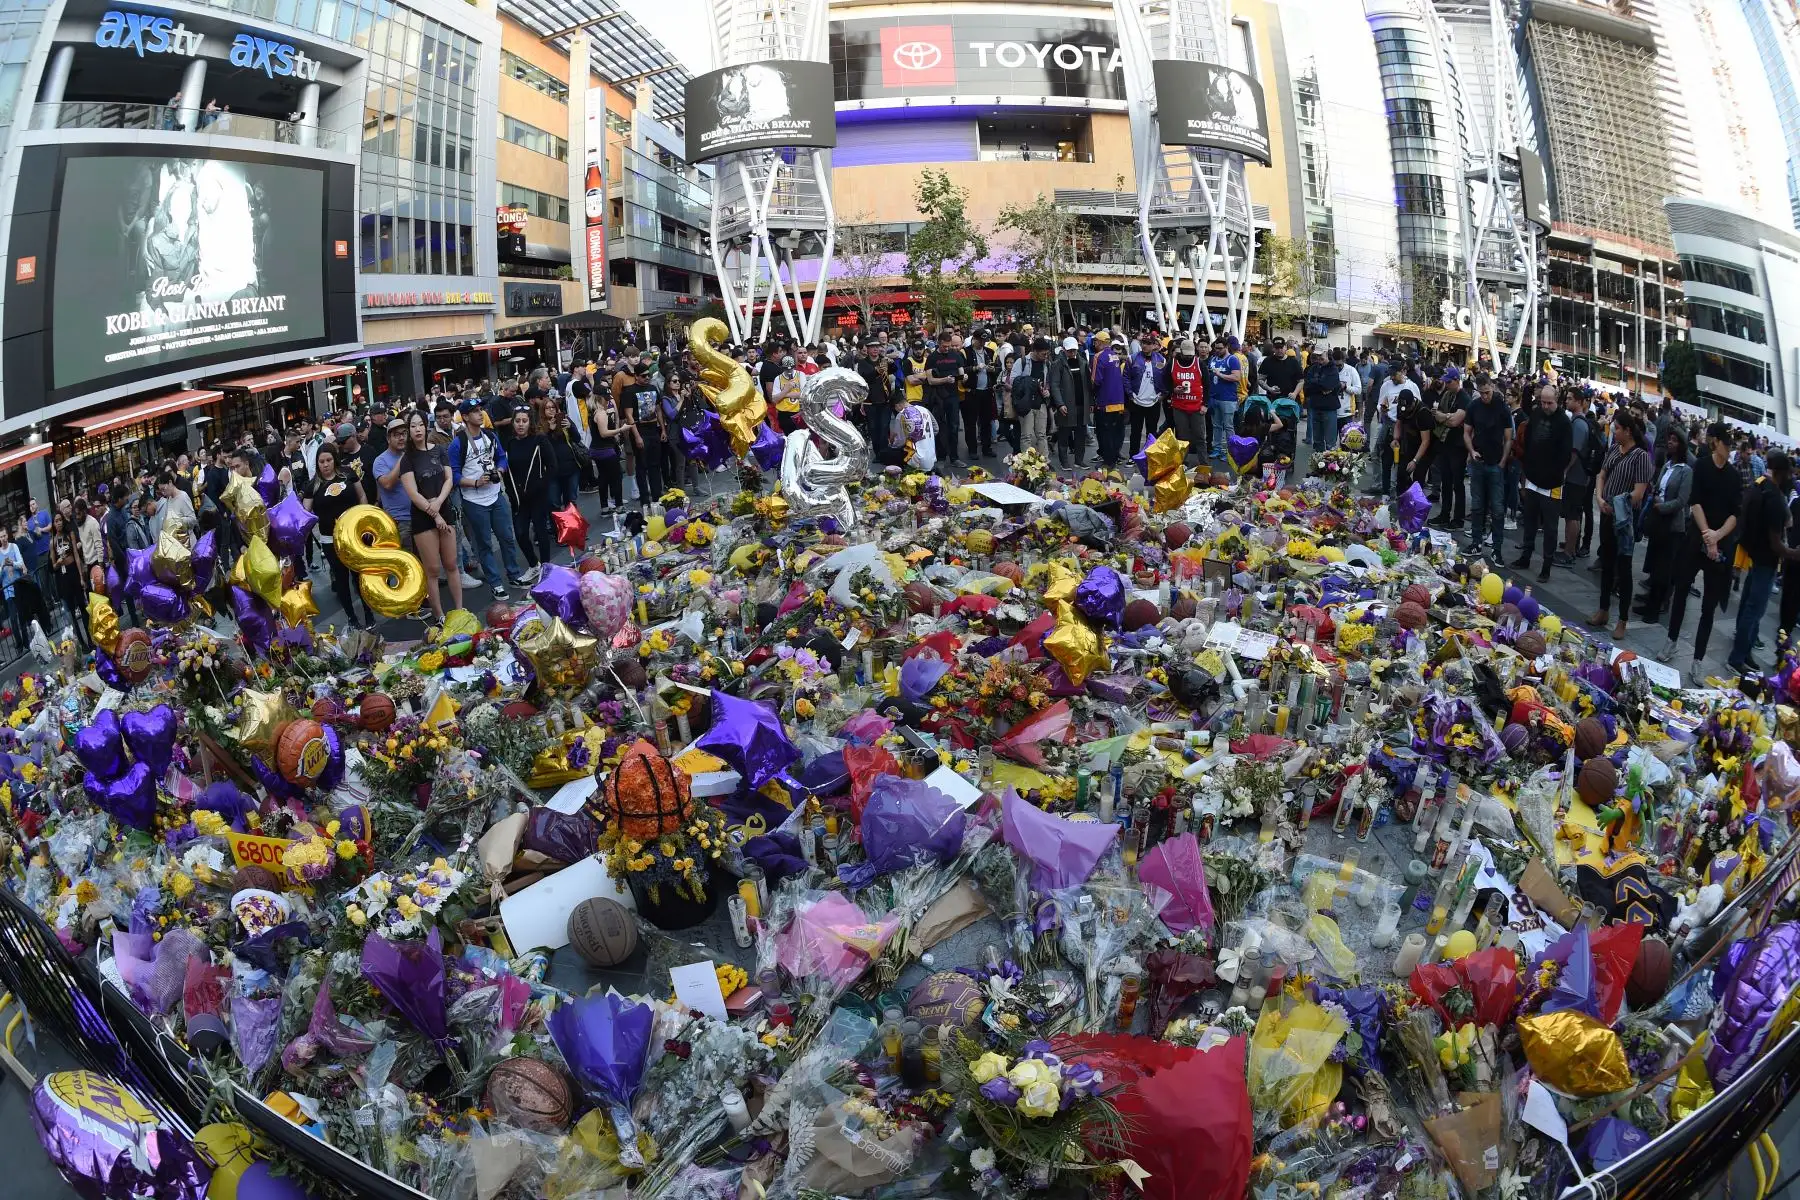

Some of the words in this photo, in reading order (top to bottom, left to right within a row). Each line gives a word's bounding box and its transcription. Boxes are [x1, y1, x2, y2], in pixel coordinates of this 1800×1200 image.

[95, 10, 204, 57] axs.tv
[229, 33, 321, 81] axs.tv
[969, 42, 1125, 73] TOYOTA
[771, 120, 811, 129] BRYANT
[497, 212, 528, 224] CONGA
[590, 229, 601, 261] CONGA
[152, 277, 186, 298] Rest
[591, 261, 602, 288] ROOM
[366, 292, 417, 307] WOLFGANG
[420, 292, 443, 305] PUCK
[445, 292, 461, 304] BAR
[463, 292, 471, 304] &
[473, 292, 495, 304] GRILL
[105, 311, 151, 335] KOBE
[169, 300, 230, 324] GIANNA
[231, 295, 287, 315] BRYANT
[1180, 372, 1195, 380] NBA
[1510, 892, 1536, 917] 8
[578, 905, 603, 954] SPALDING
[918, 1002, 953, 1019] LAKERS
